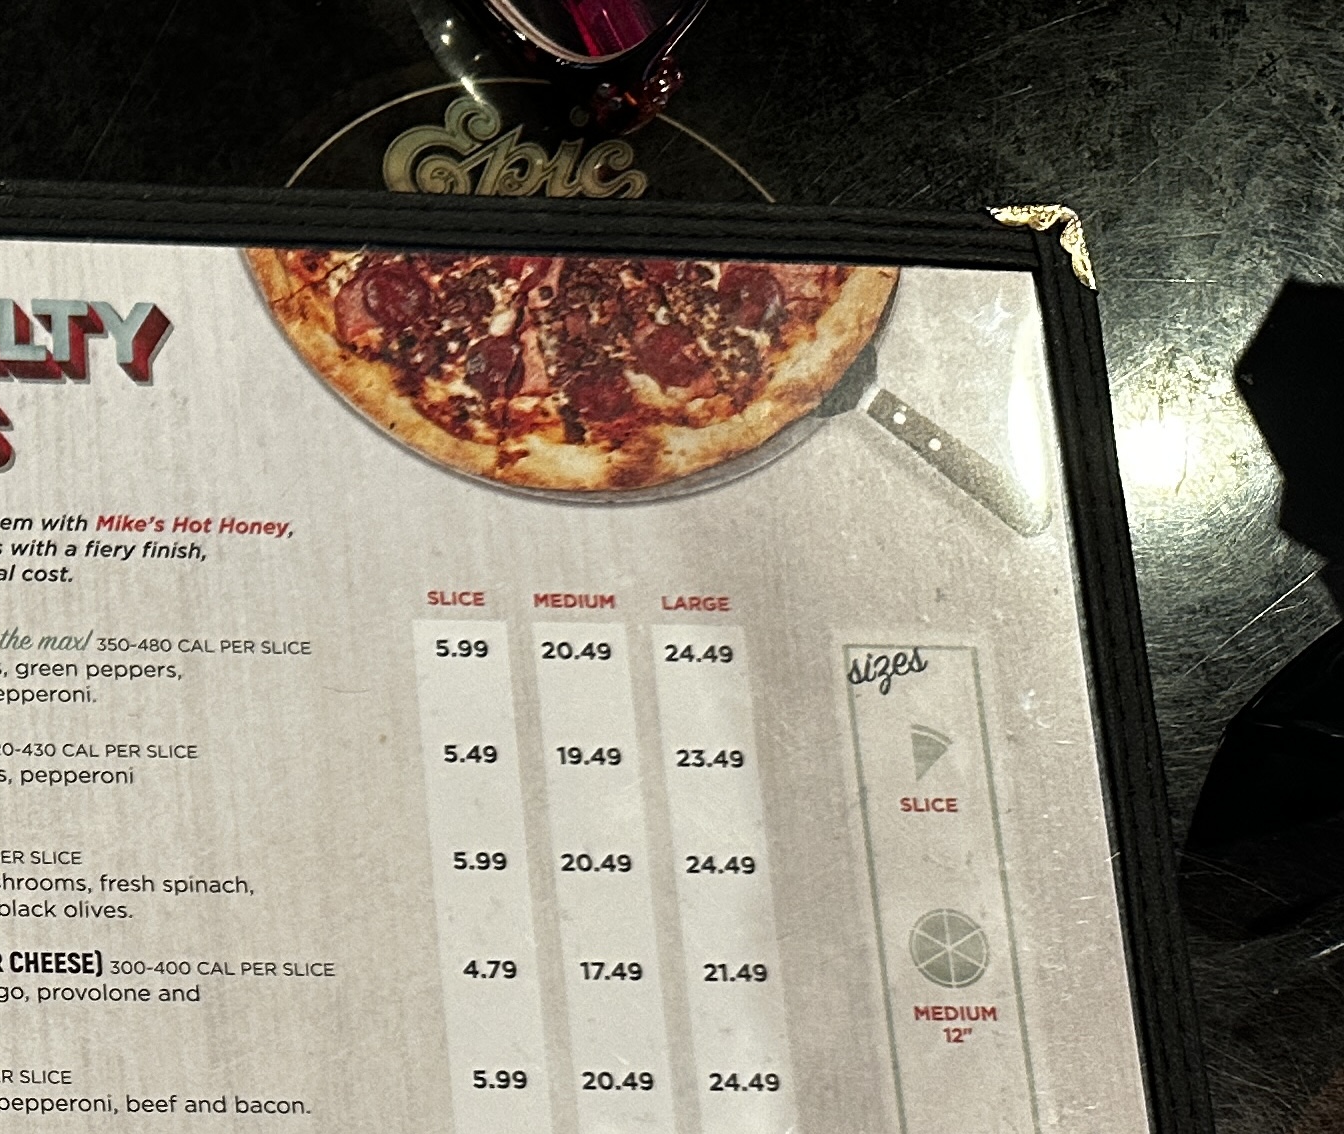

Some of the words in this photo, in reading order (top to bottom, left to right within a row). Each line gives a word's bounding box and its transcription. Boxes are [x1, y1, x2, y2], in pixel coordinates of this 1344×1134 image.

[428, 591, 485, 606] SLICE
[534, 594, 615, 608] MEDIUM
[662, 597, 730, 611] LARGE
[0, 627, 32, 651] the
[97, 638, 171, 652] 350-480
[178, 639, 214, 652] CAL
[221, 640, 254, 653] PER
[261, 641, 311, 654] SLICE
[437, 640, 488, 658] 5.99
[542, 642, 611, 660] 20.49
[665, 645, 733, 663] 24.49
[848, 646, 928, 694] sizes
[900, 797, 958, 813] SLICE
[10, 950, 102, 977] CHEESE)
[111, 961, 190, 975] 300-400
[198, 962, 235, 975] CAL
[241, 962, 276, 976] PER
[283, 963, 335, 976] SLICE
[914, 1005, 997, 1022] MEDIUM
